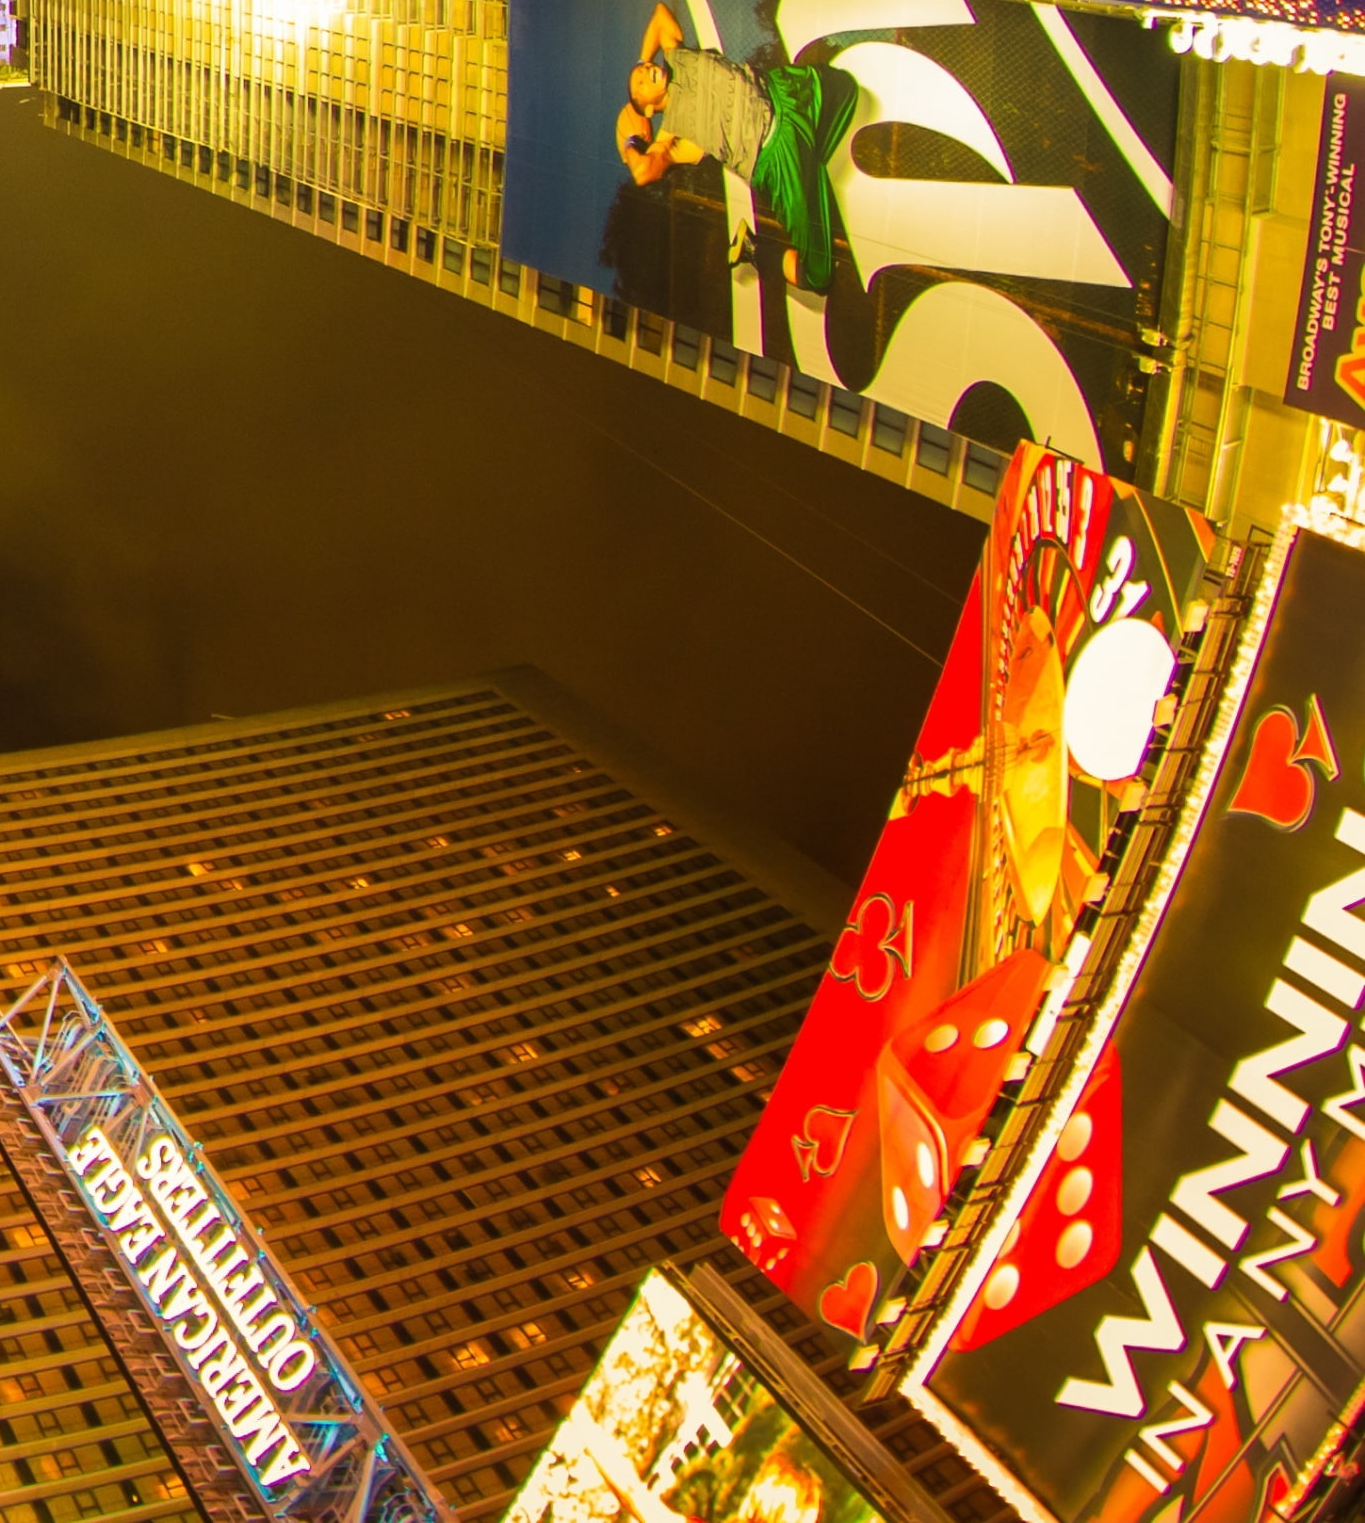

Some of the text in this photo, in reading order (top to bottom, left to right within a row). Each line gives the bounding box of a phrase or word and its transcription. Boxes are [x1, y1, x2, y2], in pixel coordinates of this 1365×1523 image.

[1297, 257, 1329, 392] BROADWAY'S
[1322, 271, 1341, 331] BEST
[1332, 164, 1357, 266] MUSICAL
[67, 1126, 311, 1487] AMERICAN EAGLE
[137, 1137, 316, 1393] OUTFITTERS
[1123, 1376, 1215, 1496] IN
[1202, 1319, 1268, 1391] A
[1240, 1137, 1344, 1303] NY
